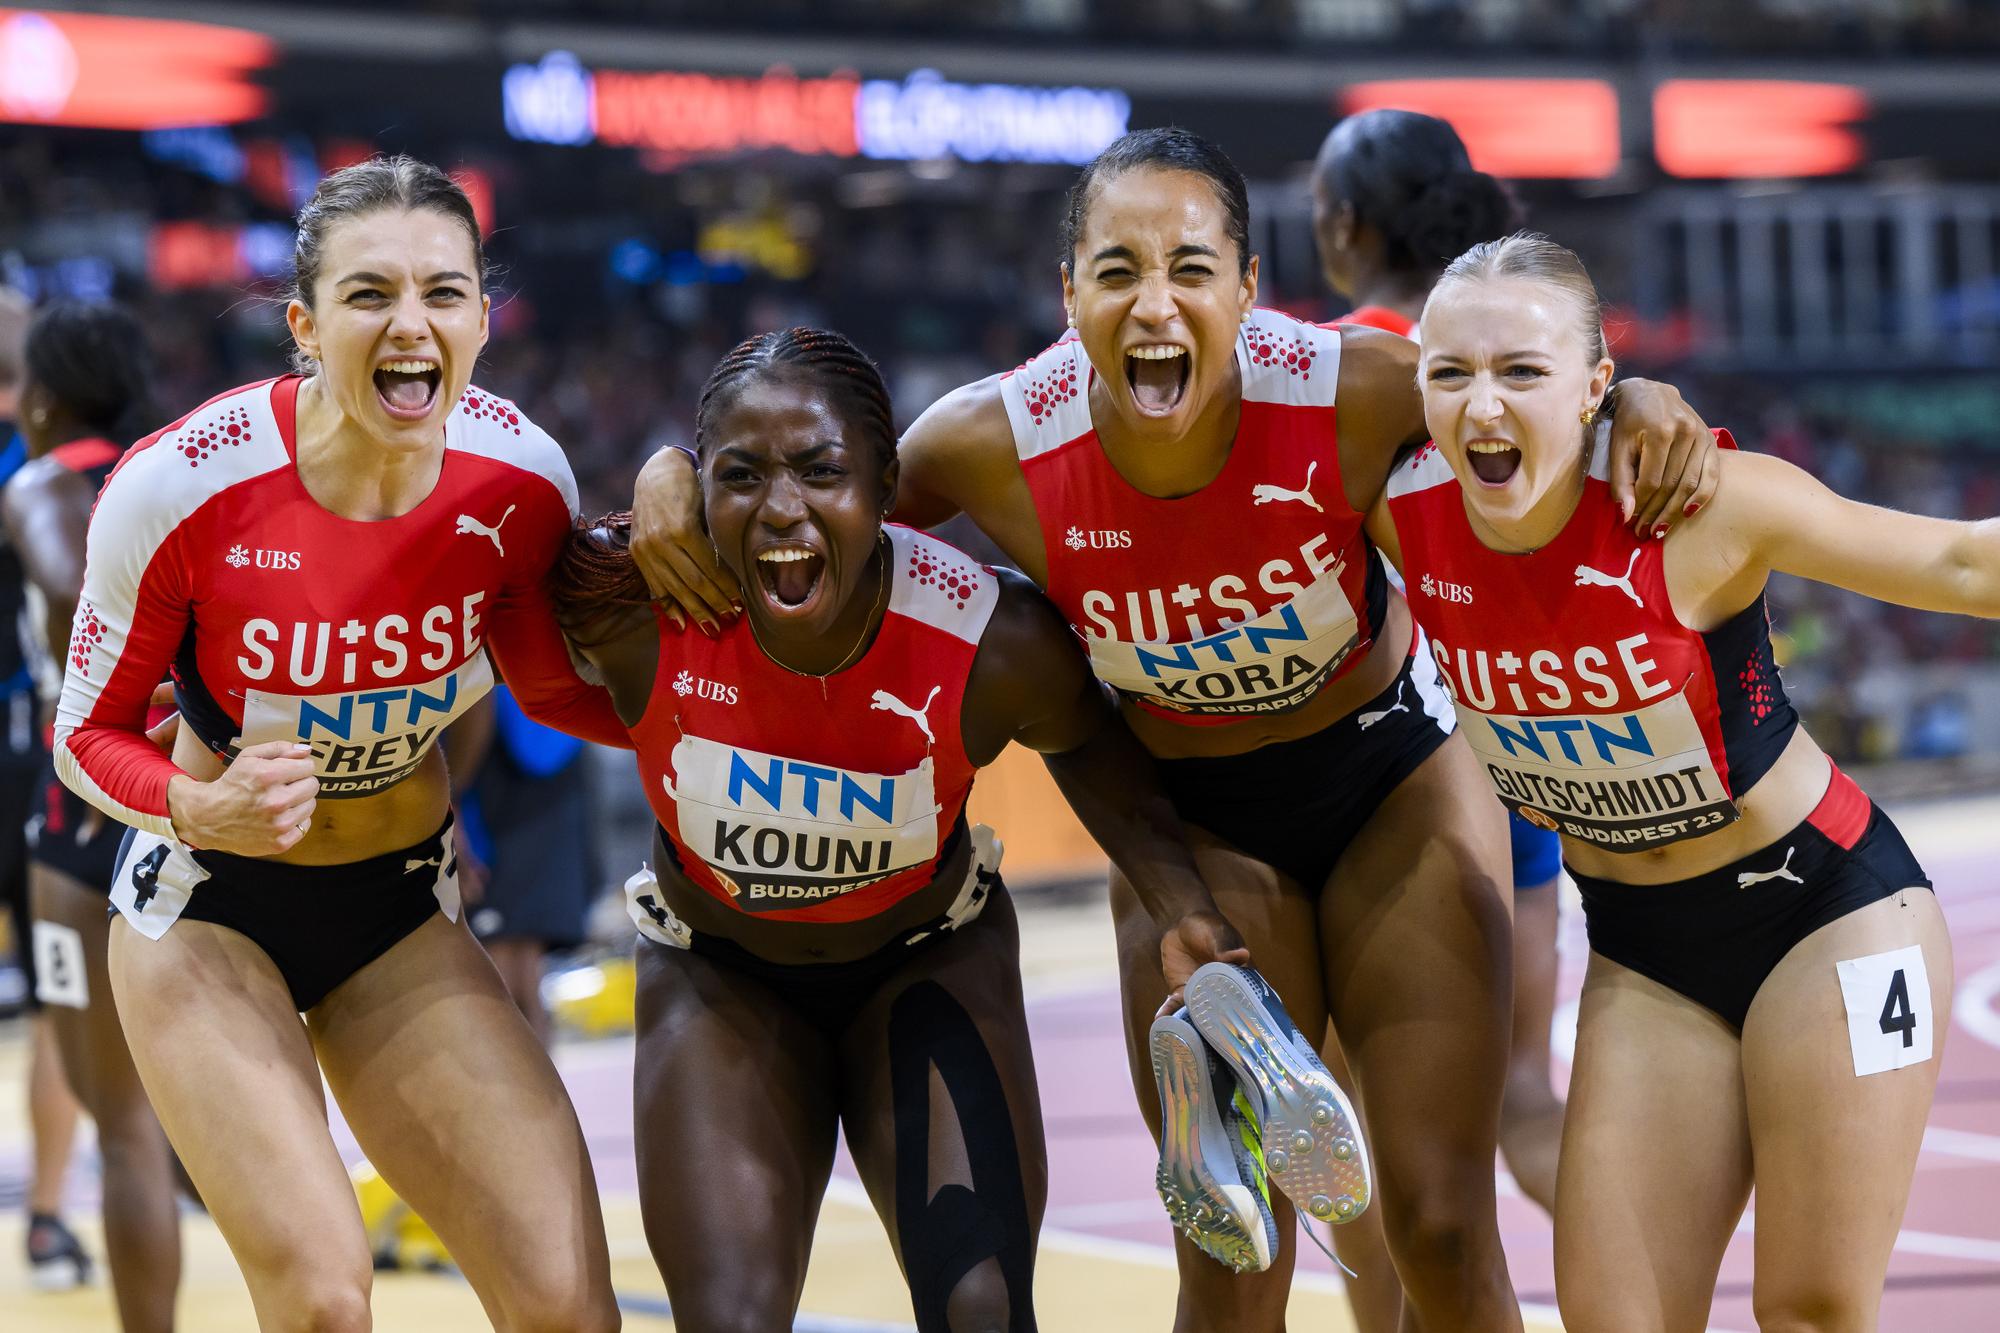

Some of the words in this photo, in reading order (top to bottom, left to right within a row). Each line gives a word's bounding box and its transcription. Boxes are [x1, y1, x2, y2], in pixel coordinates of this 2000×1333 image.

[255, 549, 301, 570] UBS
[1089, 530, 1132, 549] UBS
[1438, 580, 1473, 604] UBS
[1134, 603, 1309, 678] NTN
[697, 678, 738, 704] UBS
[1155, 653, 1318, 700] KORA
[1200, 670, 1328, 713] BUDAPEST
[297, 673, 458, 741] NTN
[1486, 714, 1655, 767] NTN
[318, 766, 417, 792] UDAPES
[728, 750, 895, 825] NTN
[1487, 763, 1710, 817] GUTSCHMIDT
[714, 820, 892, 874] KOUNI
[1564, 819, 1689, 844] BUDAPEST
[1693, 811, 1725, 829] 23
[132, 843, 171, 913] 4
[1879, 969, 1916, 1048] 4
